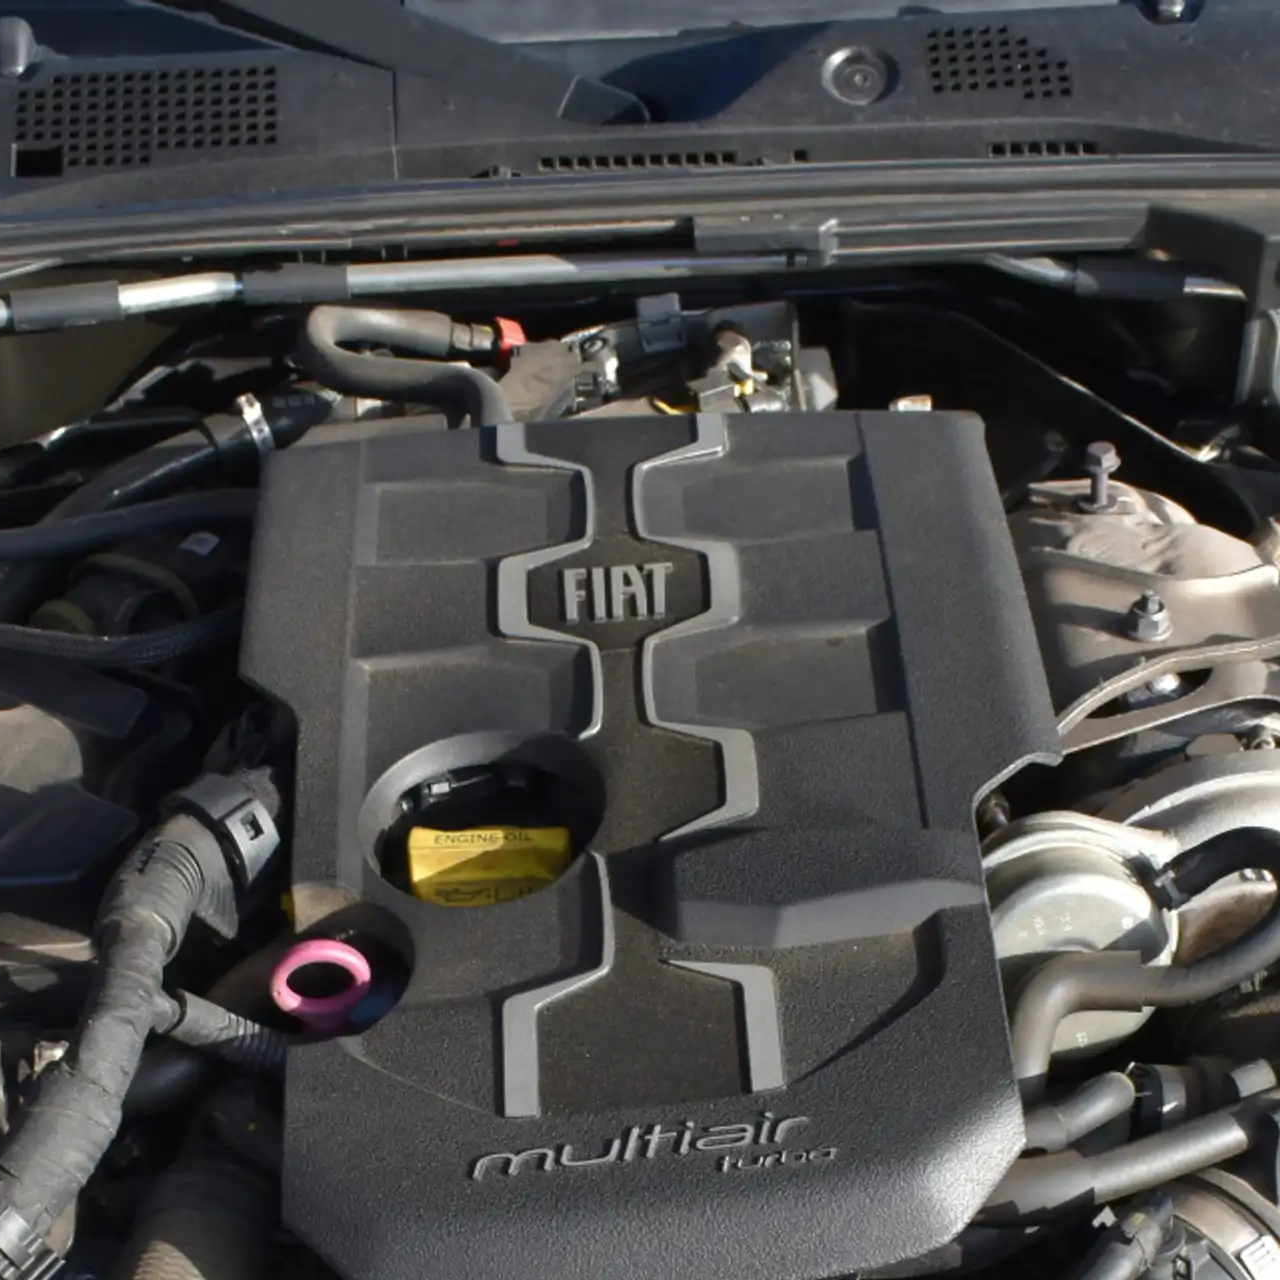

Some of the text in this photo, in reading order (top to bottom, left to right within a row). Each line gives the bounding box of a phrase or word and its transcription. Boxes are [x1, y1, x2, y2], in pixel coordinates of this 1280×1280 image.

[562, 562, 674, 625] FIAT
[433, 832, 534, 846] ENGINE OIL
[470, 1111, 810, 1182] multiair
